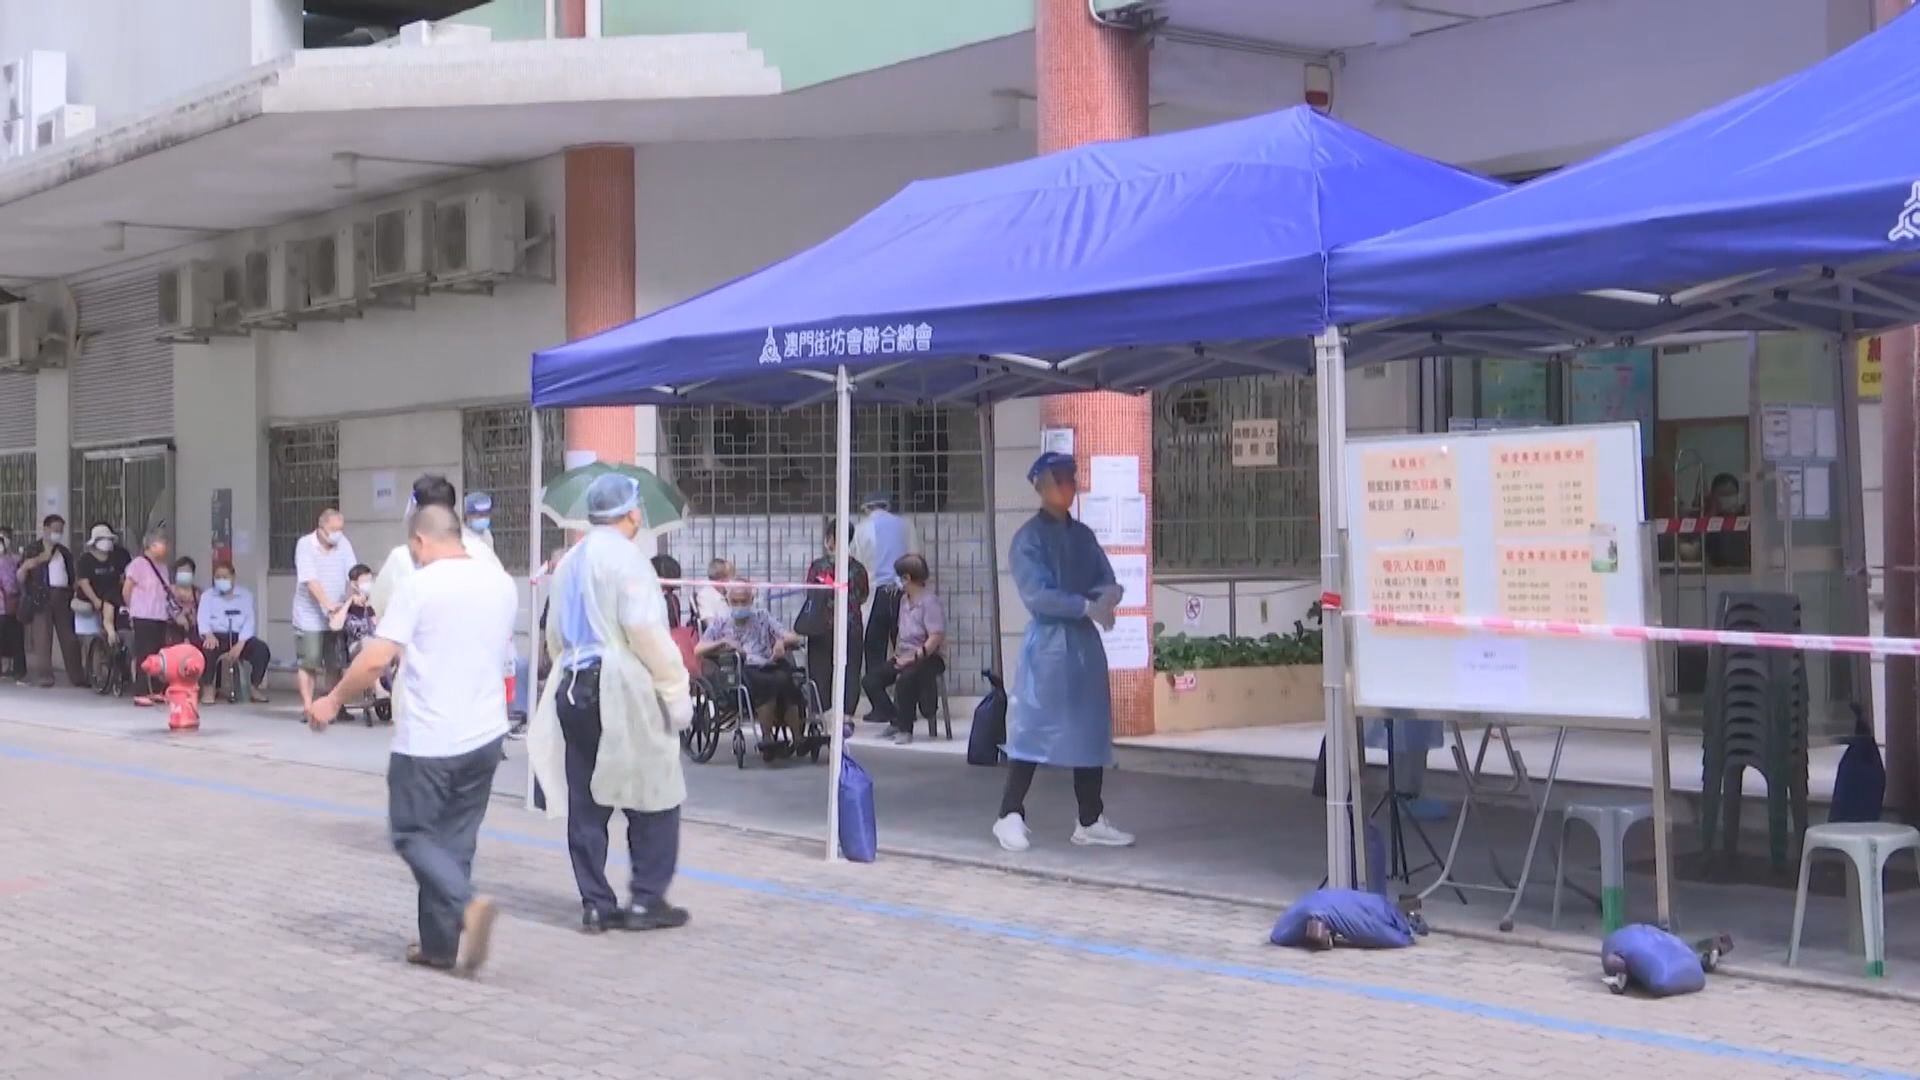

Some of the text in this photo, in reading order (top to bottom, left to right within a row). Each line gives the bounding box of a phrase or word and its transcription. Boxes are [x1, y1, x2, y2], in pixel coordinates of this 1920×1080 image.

[784, 321, 932, 358] 澳門街坊會聯合總會
